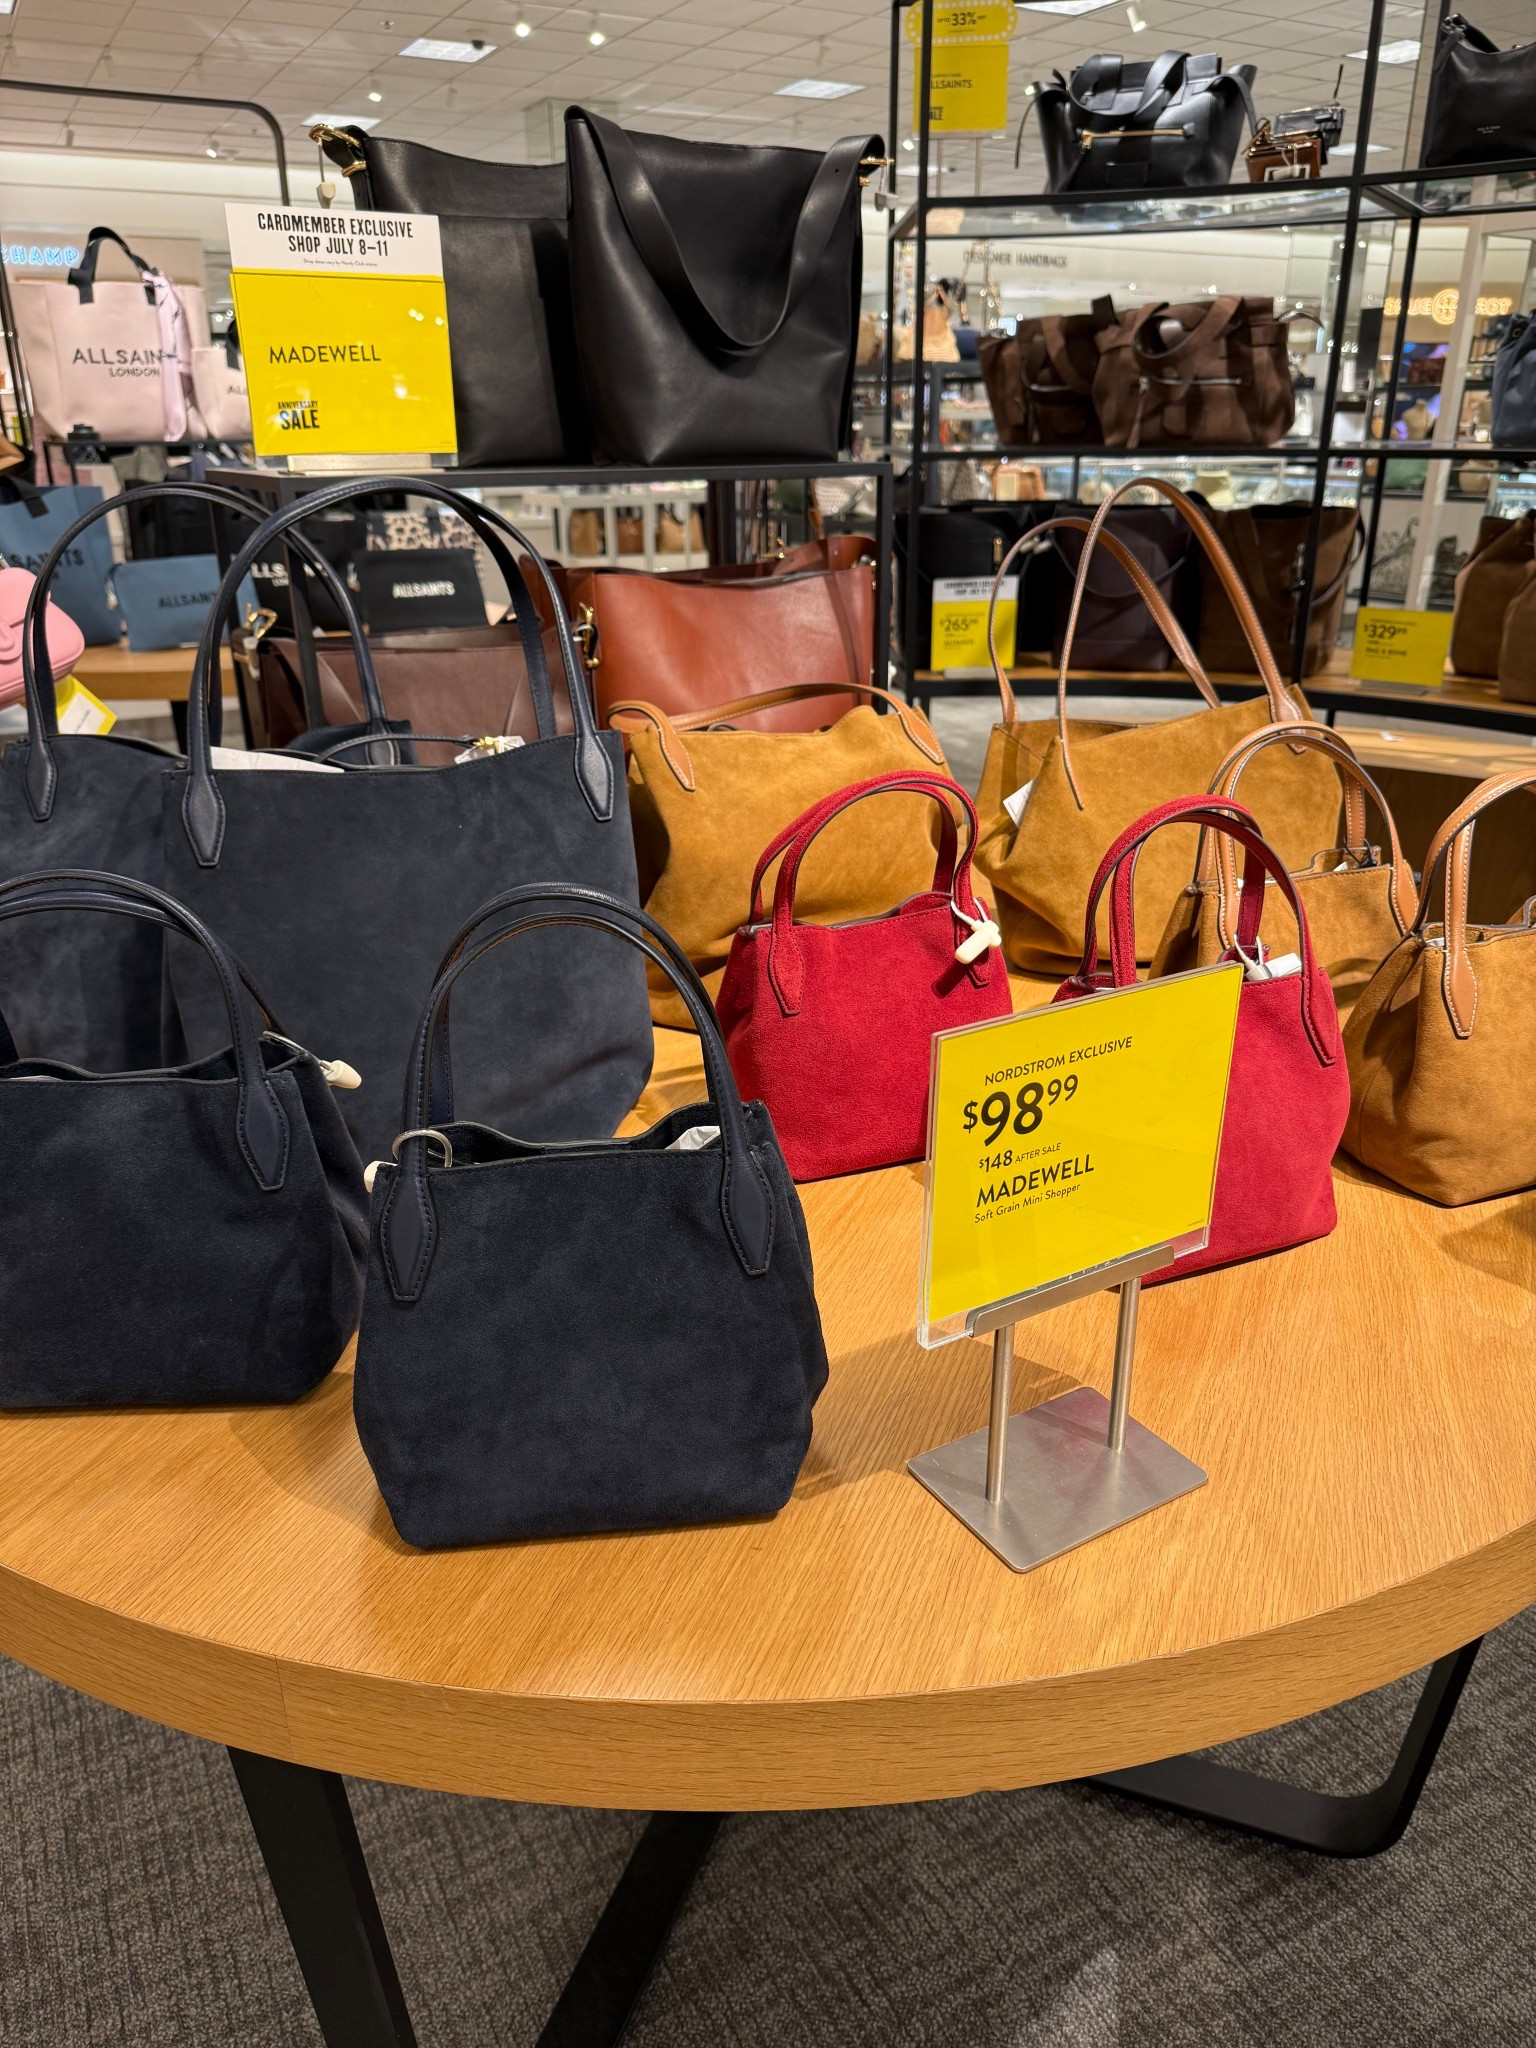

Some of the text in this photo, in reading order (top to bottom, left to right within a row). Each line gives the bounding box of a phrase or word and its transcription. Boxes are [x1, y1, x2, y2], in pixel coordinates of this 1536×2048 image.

[258, 213, 413, 238] CARDMEMBER EXCLUSIVE
[288, 235, 321, 253] SHOP
[326, 238, 353, 255] JULY
[269, 345, 381, 364] MADEWELL
[278, 401, 318, 410] ANNIVERSARY
[279, 409, 320, 430] SALE
[393, 580, 455, 598] ALLSAINTS
[985, 1036, 1133, 1086] NORDSTROM EXCLUSIVE
[979, 1142, 1062, 1173] $148 AFTER SALE
[976, 1154, 1095, 1208] MADEWELL
[975, 1184, 1081, 1224] Soft Grain Mini Shopper
